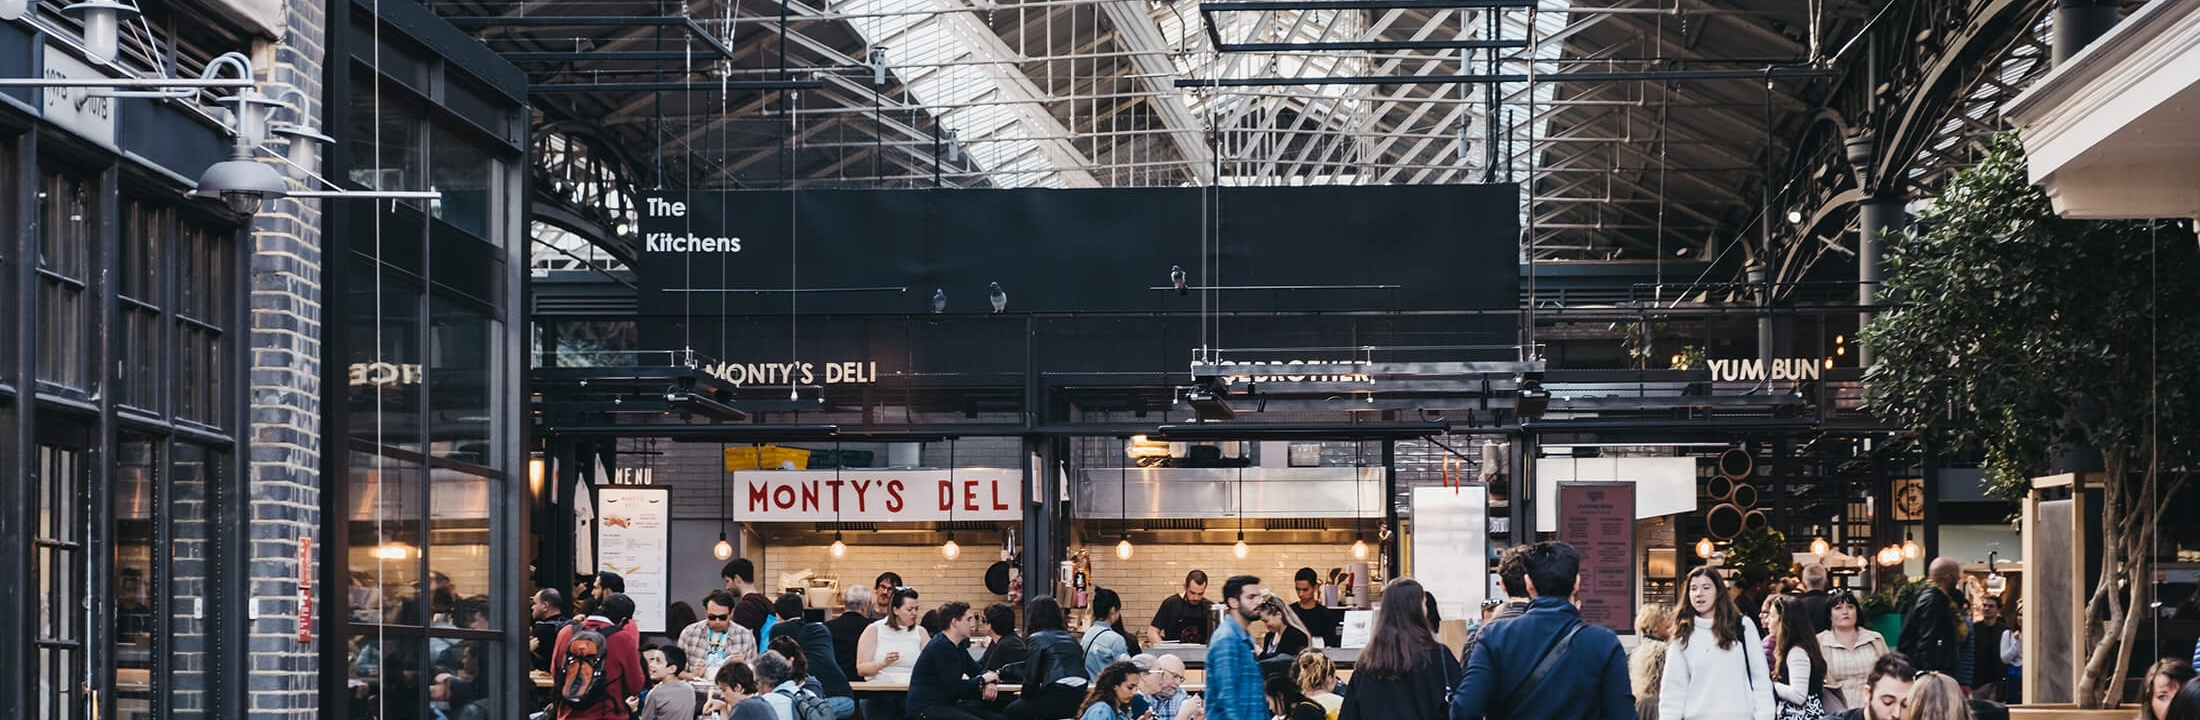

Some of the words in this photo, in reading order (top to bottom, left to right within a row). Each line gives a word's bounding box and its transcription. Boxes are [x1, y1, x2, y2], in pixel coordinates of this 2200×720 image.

[647, 198, 686, 216] The
[646, 233, 741, 252] Kitchens
[705, 361, 814, 384] MONTY'S
[826, 361, 876, 383] DELI
[1707, 358, 1765, 381] YUM
[1772, 358, 1819, 380] BUN
[614, 467, 652, 485] MENU
[749, 479, 904, 513] MONTY'S
